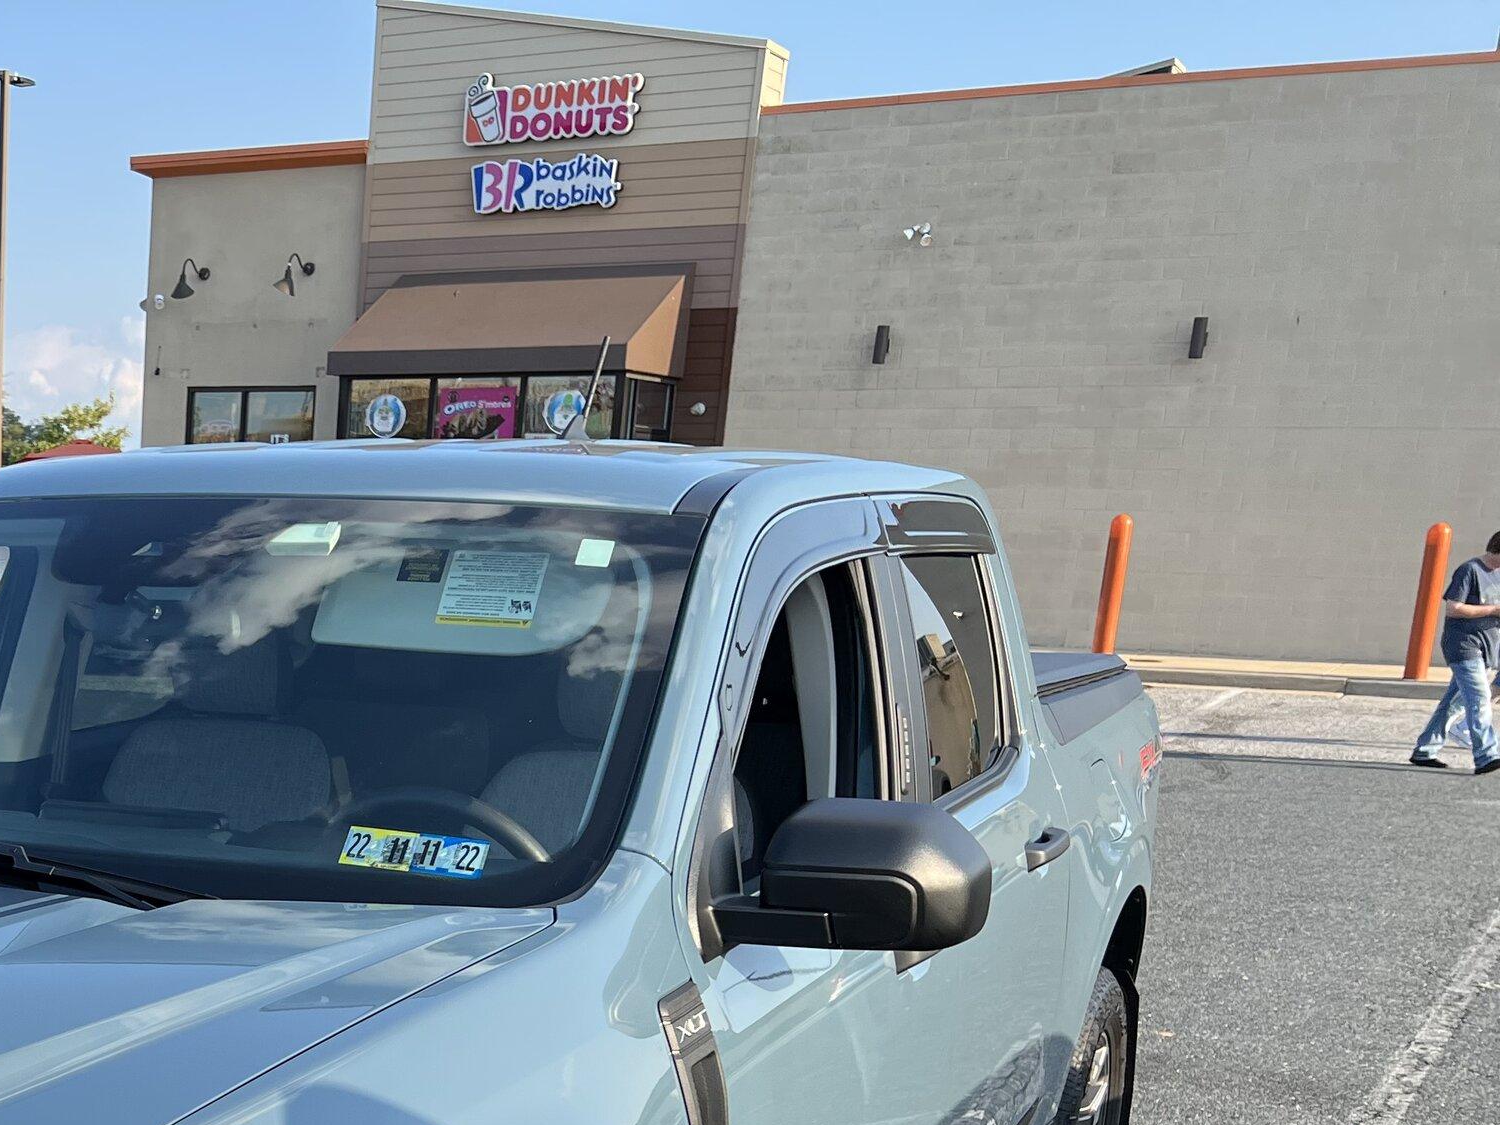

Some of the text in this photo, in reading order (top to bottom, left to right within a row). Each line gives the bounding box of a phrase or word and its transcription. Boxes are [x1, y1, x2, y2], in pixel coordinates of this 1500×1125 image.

[511, 76, 641, 112] DUNKIN'
[509, 105, 630, 140] DONUTS
[443, 401, 477, 415] OREO
[346, 832, 411, 864] 22 11
[420, 839, 481, 872] 11 22
[676, 1008, 708, 1043] XLT
